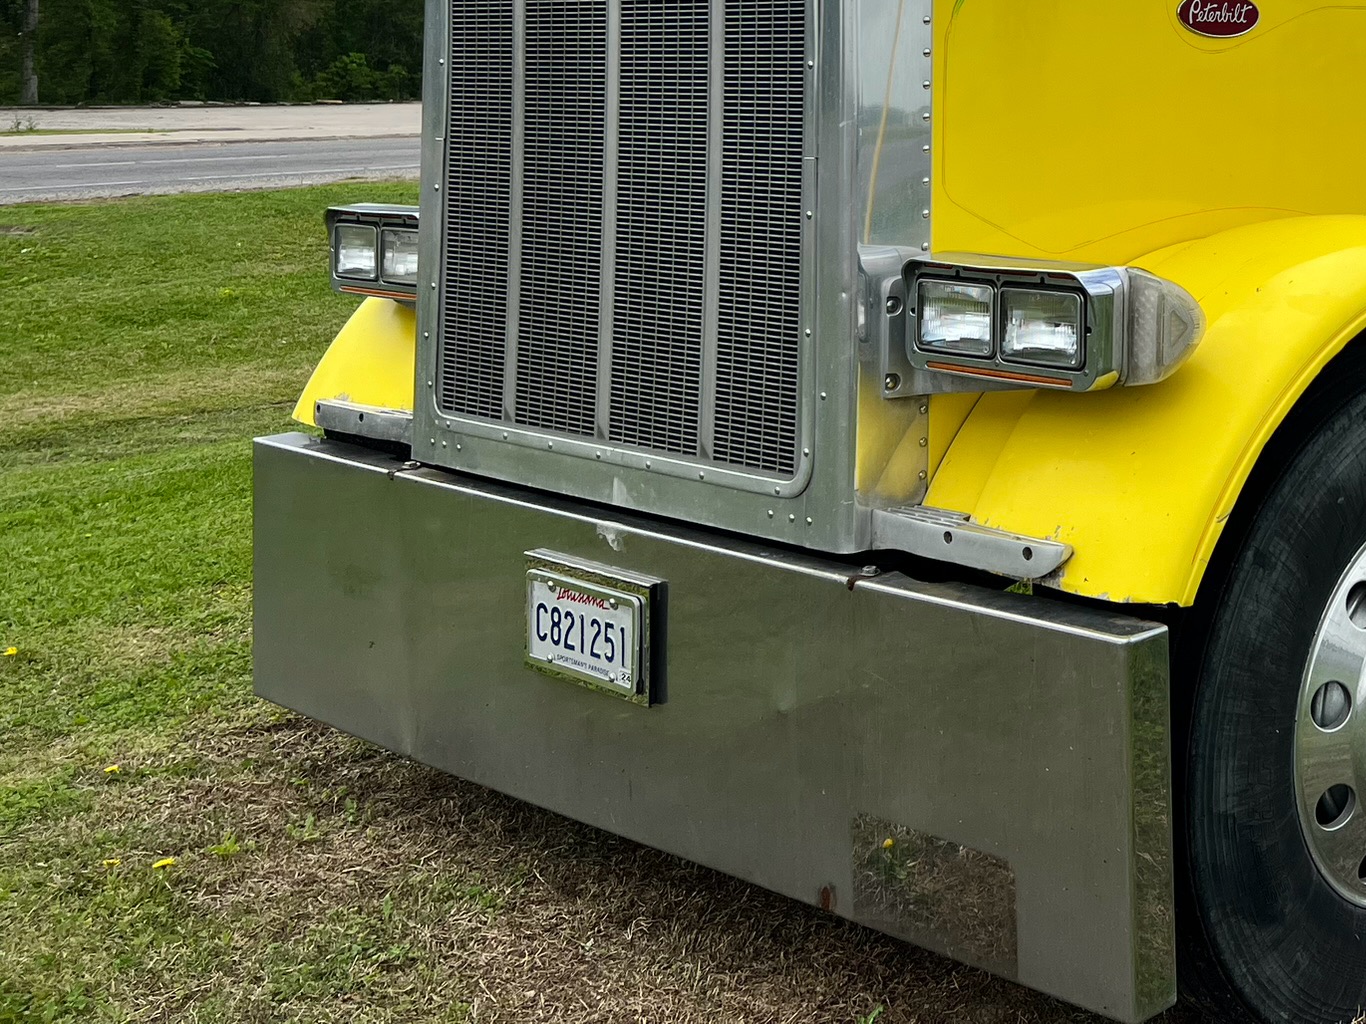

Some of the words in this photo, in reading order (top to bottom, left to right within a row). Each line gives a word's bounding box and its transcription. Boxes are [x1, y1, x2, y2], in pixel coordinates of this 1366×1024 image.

[557, 587, 610, 610] Louisiana
[536, 602, 626, 668] C821251
[588, 663, 610, 677] PARADISE
